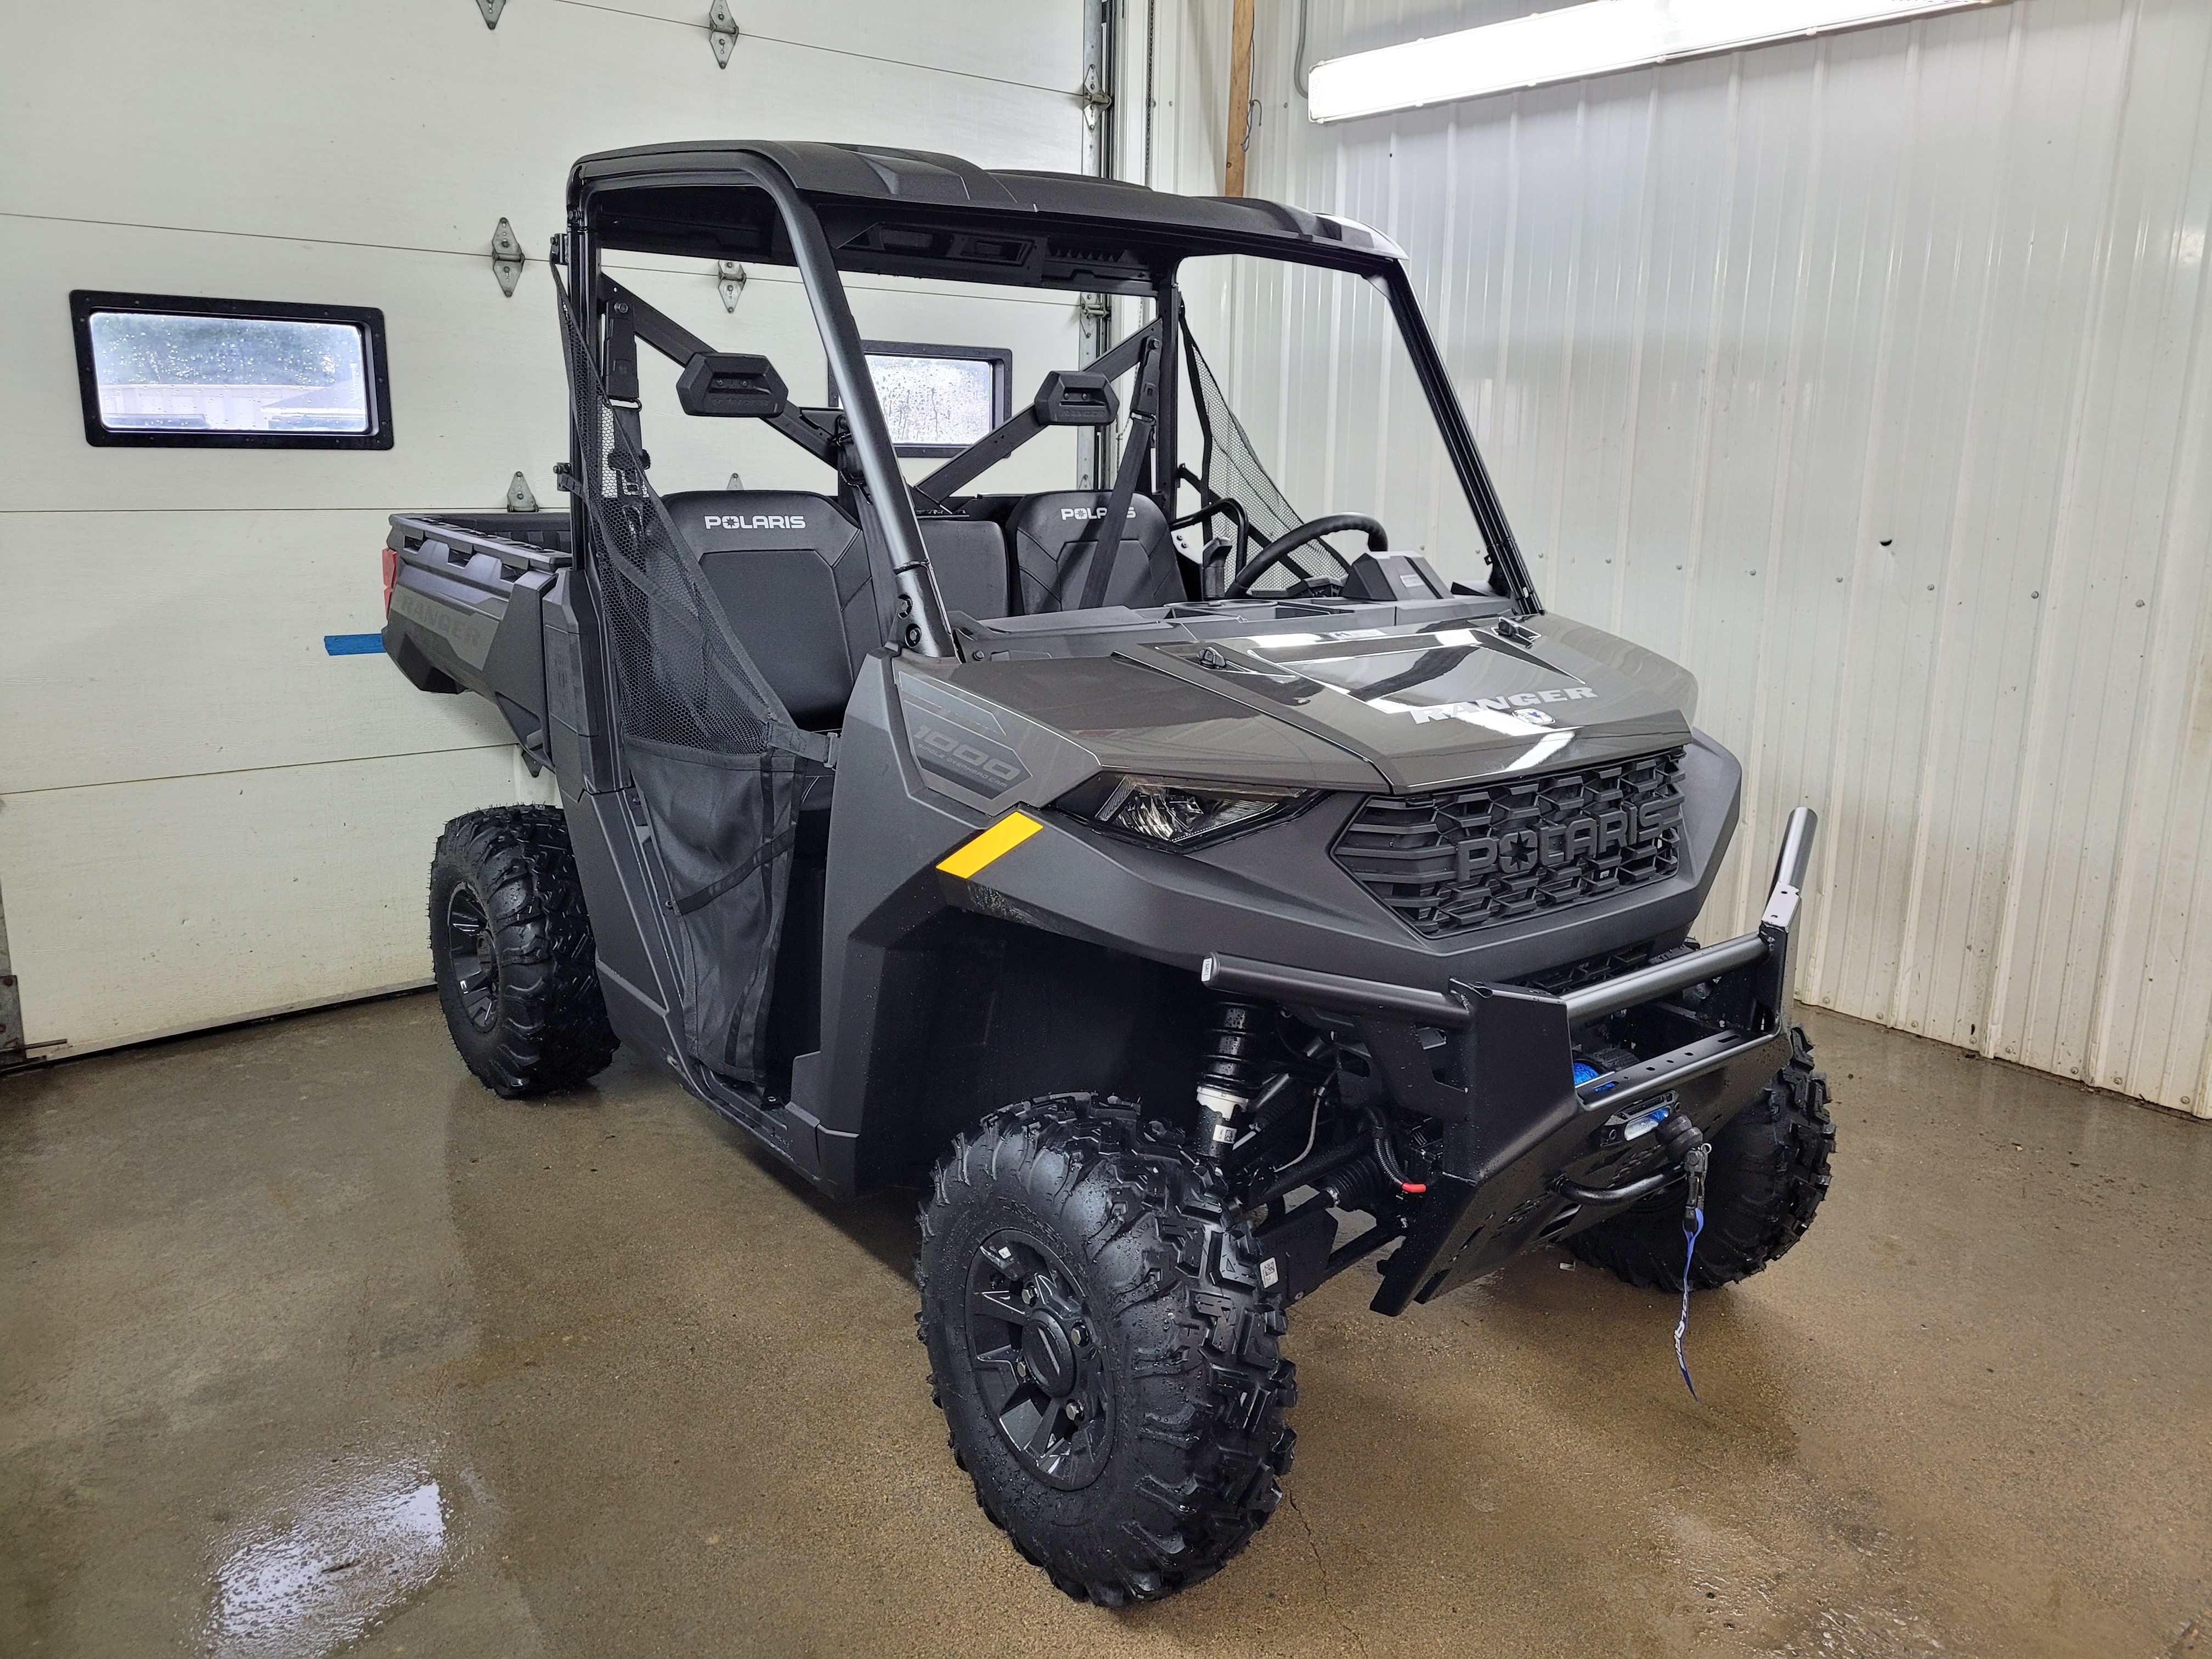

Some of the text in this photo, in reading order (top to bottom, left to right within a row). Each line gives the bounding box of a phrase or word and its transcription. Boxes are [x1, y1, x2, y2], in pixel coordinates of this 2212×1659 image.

[704, 515, 806, 530] POLARIS
[1060, 506, 1136, 521] POLAS
[1410, 686, 1599, 725] RANGER
[913, 725, 1021, 781] 1000
[917, 743, 1008, 788] SINGLE OVERHEAD CAM
[1457, 803, 1664, 882] POLARIS
